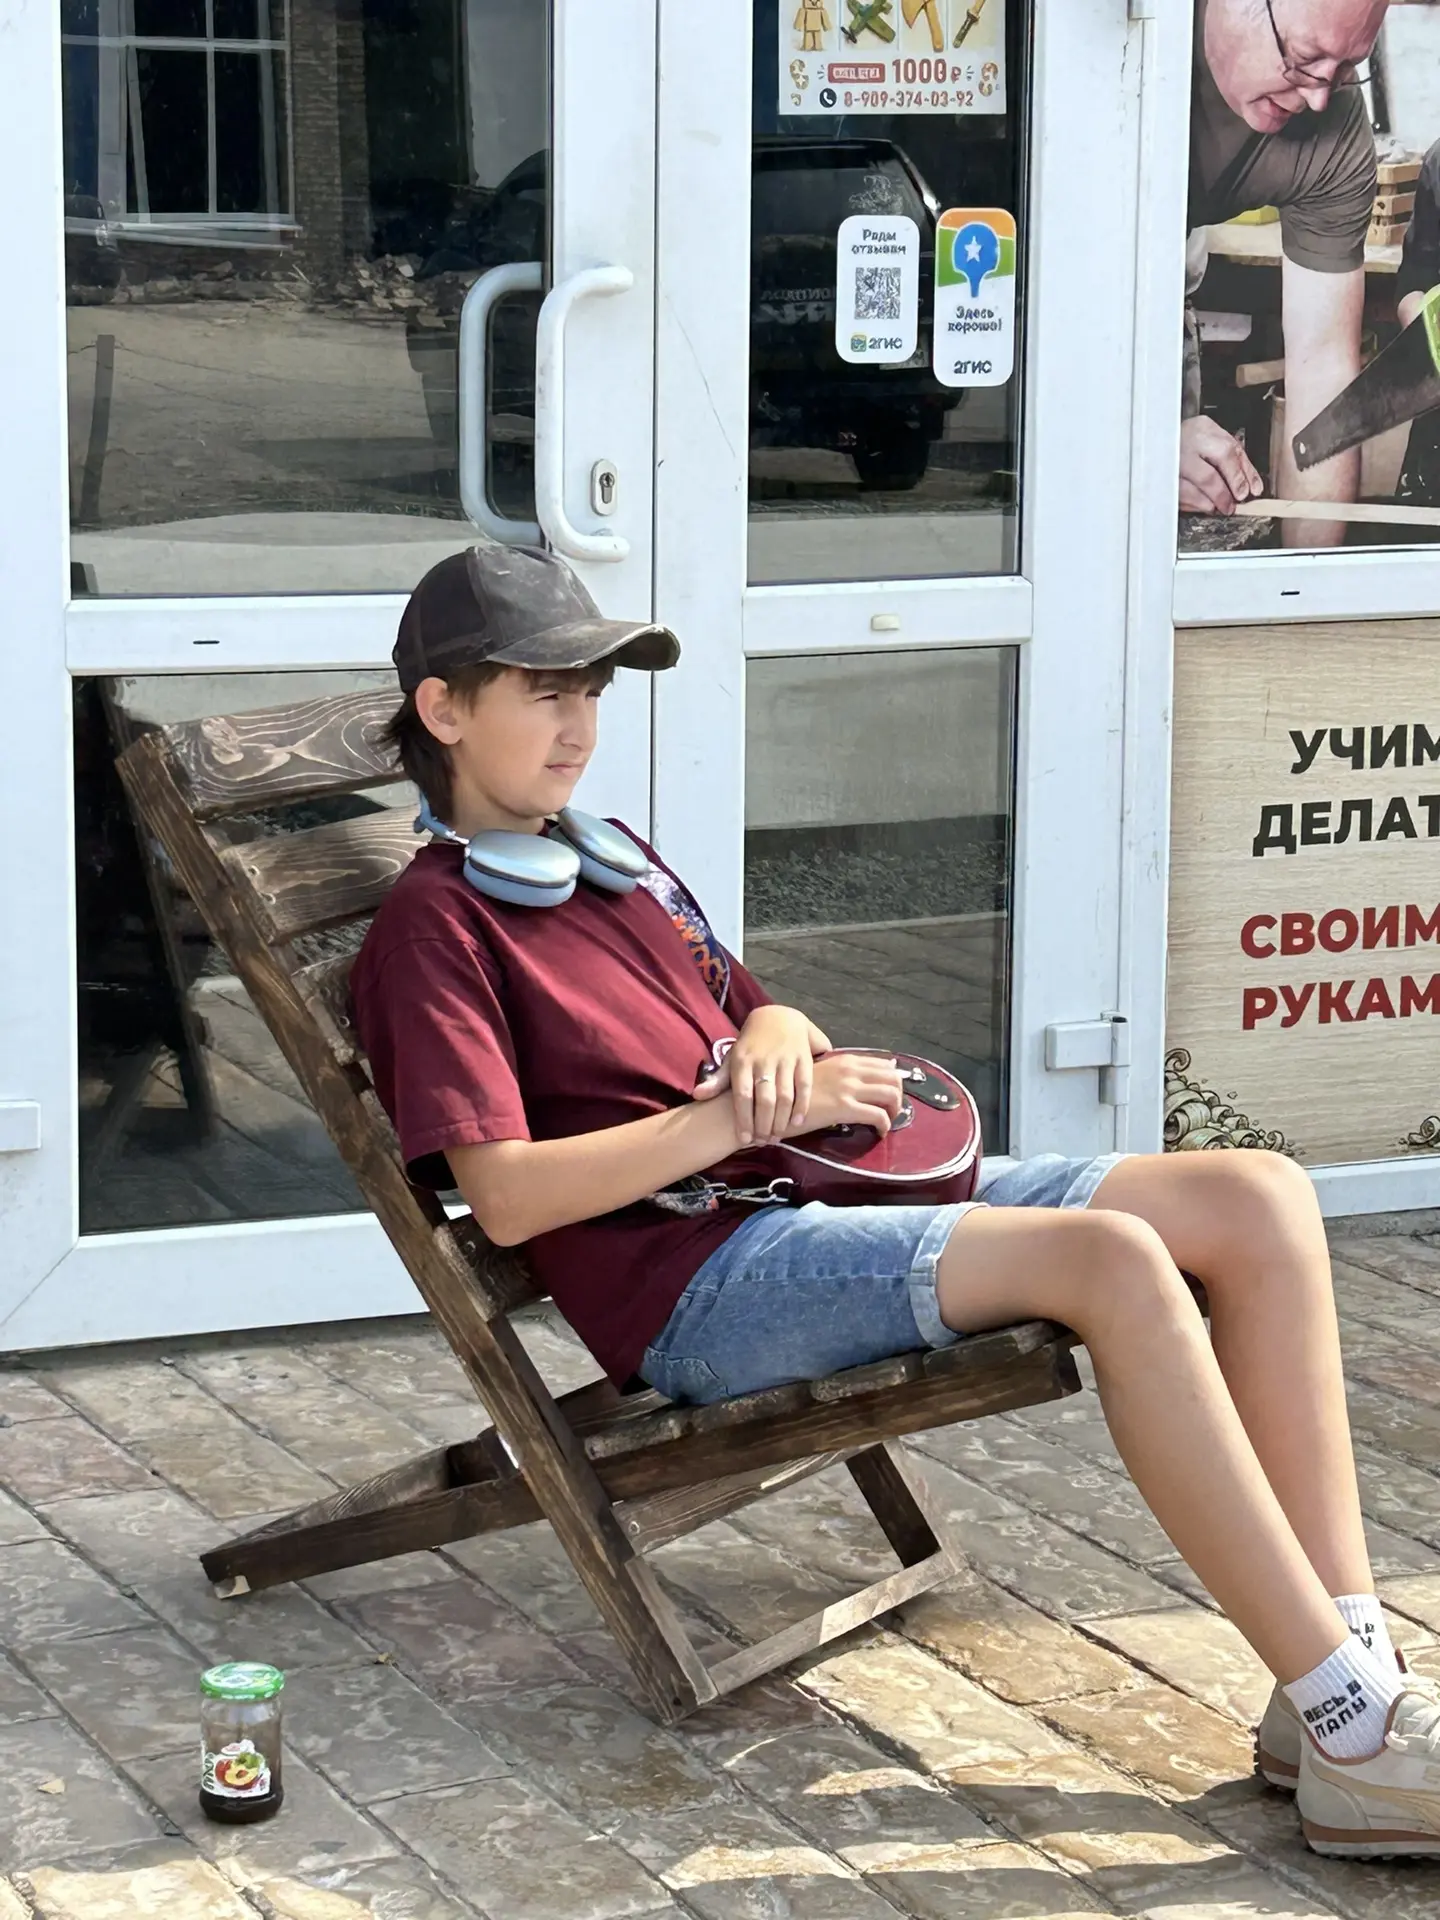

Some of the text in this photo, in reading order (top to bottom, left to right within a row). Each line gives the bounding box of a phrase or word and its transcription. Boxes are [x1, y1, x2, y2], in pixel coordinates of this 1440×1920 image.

[892, 58, 947, 84] 1000
[844, 90, 974, 108] 8-909-374-03-92
[956, 305, 995, 319] Здесь
[948, 318, 1002, 334] хорошо!
[953, 359, 993, 374] 2ГИС
[1288, 723, 1440, 774] УЧИМ
[1303, 1695, 1348, 1723] ВЕСЬ
[1314, 1697, 1367, 1740] ПАПУ
